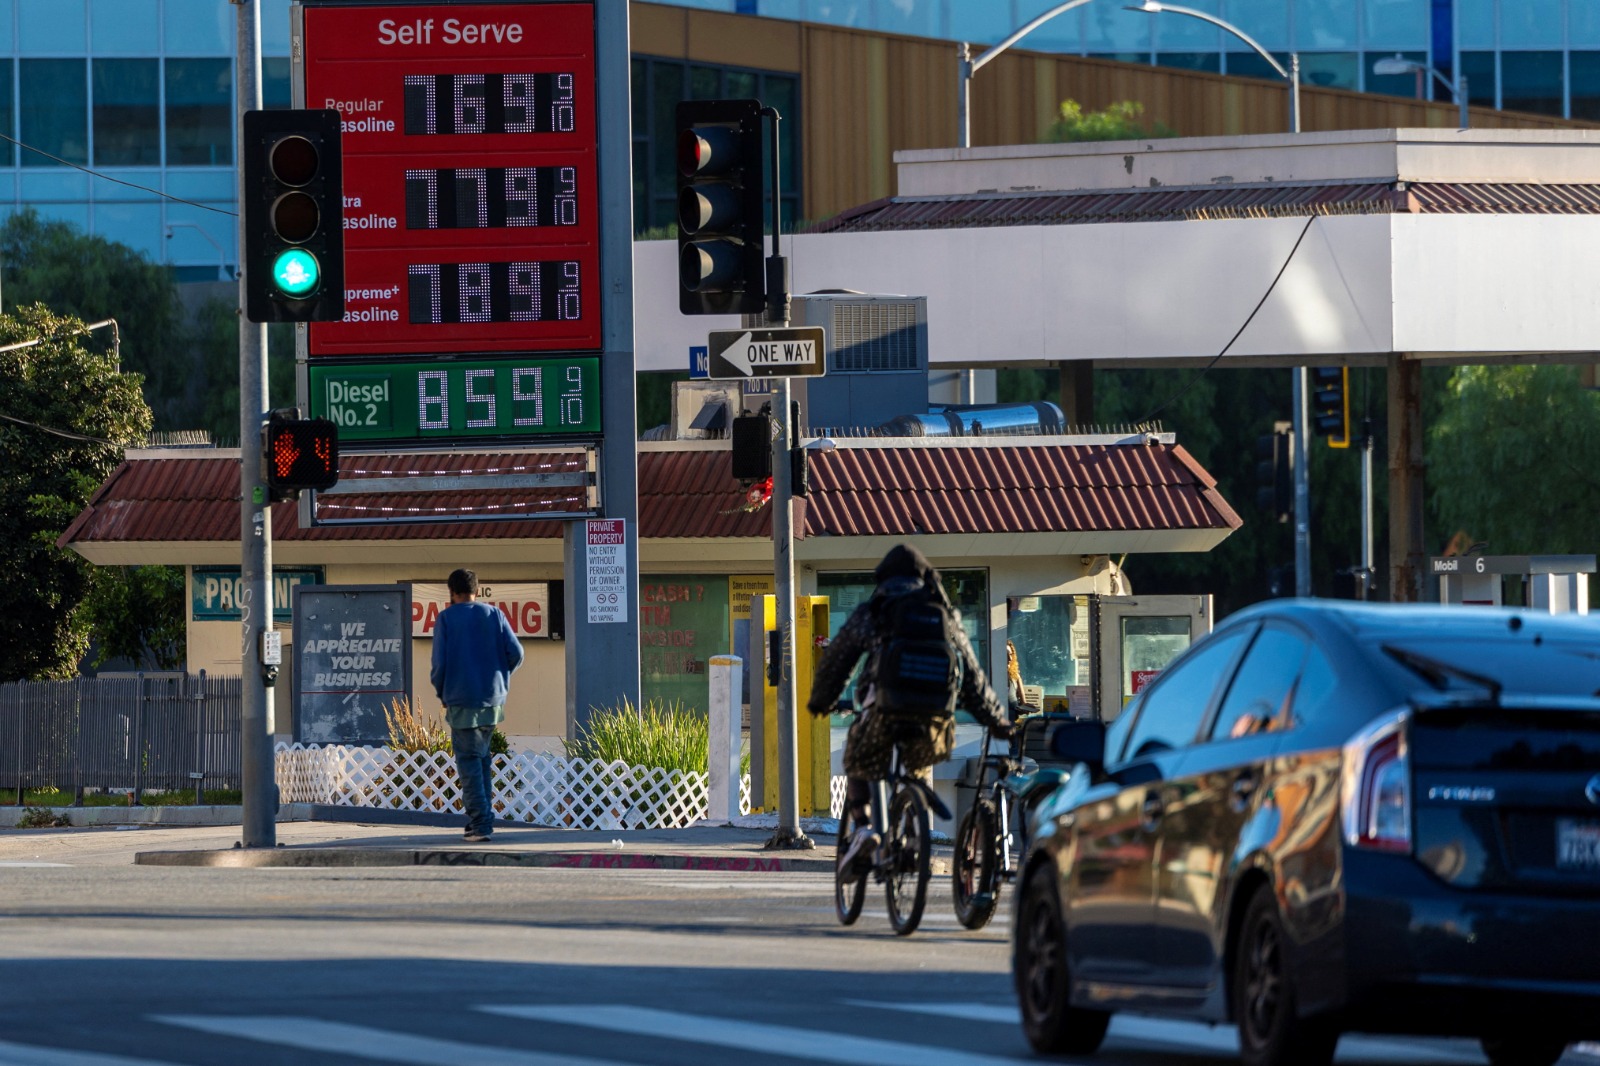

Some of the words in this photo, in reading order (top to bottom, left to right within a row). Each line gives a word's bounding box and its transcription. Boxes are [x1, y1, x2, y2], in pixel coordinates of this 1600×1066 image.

[378, 19, 434, 45] Self
[442, 18, 523, 44] Serve
[325, 98, 384, 115] Regular
[341, 117, 395, 132] asoline
[342, 195, 362, 208] tra
[342, 214, 397, 229] asoline
[344, 285, 400, 303] preme+
[342, 307, 399, 323] asoline
[747, 344, 779, 363] ONE
[783, 343, 812, 361] WAY
[329, 379, 389, 403] Diesel
[418, 366, 544, 430] 859
[315, 437, 330, 471] 4
[590, 521, 615, 532] PRIVATE
[590, 533, 623, 544] PROPERTY
[589, 546, 598, 555] NO
[600, 546, 617, 555] ENTRY
[589, 556, 615, 565] WITHOUT
[1434, 560, 1458, 572] Mobil
[1475, 557, 1485, 573] 6
[590, 566, 625, 575] PERMISSION
[590, 576, 597, 585] OF
[599, 576, 621, 585] OWNER
[205, 577, 301, 609] PRON
[475, 587, 492, 598] LIC
[643, 584, 690, 602] CASH
[412, 601, 542, 634] PANG
[640, 605, 671, 626] TM
[341, 622, 366, 636] WE
[303, 639, 401, 654] APPRECIATE
[331, 656, 376, 670] YOUR
[314, 672, 392, 687] BUSINESS
